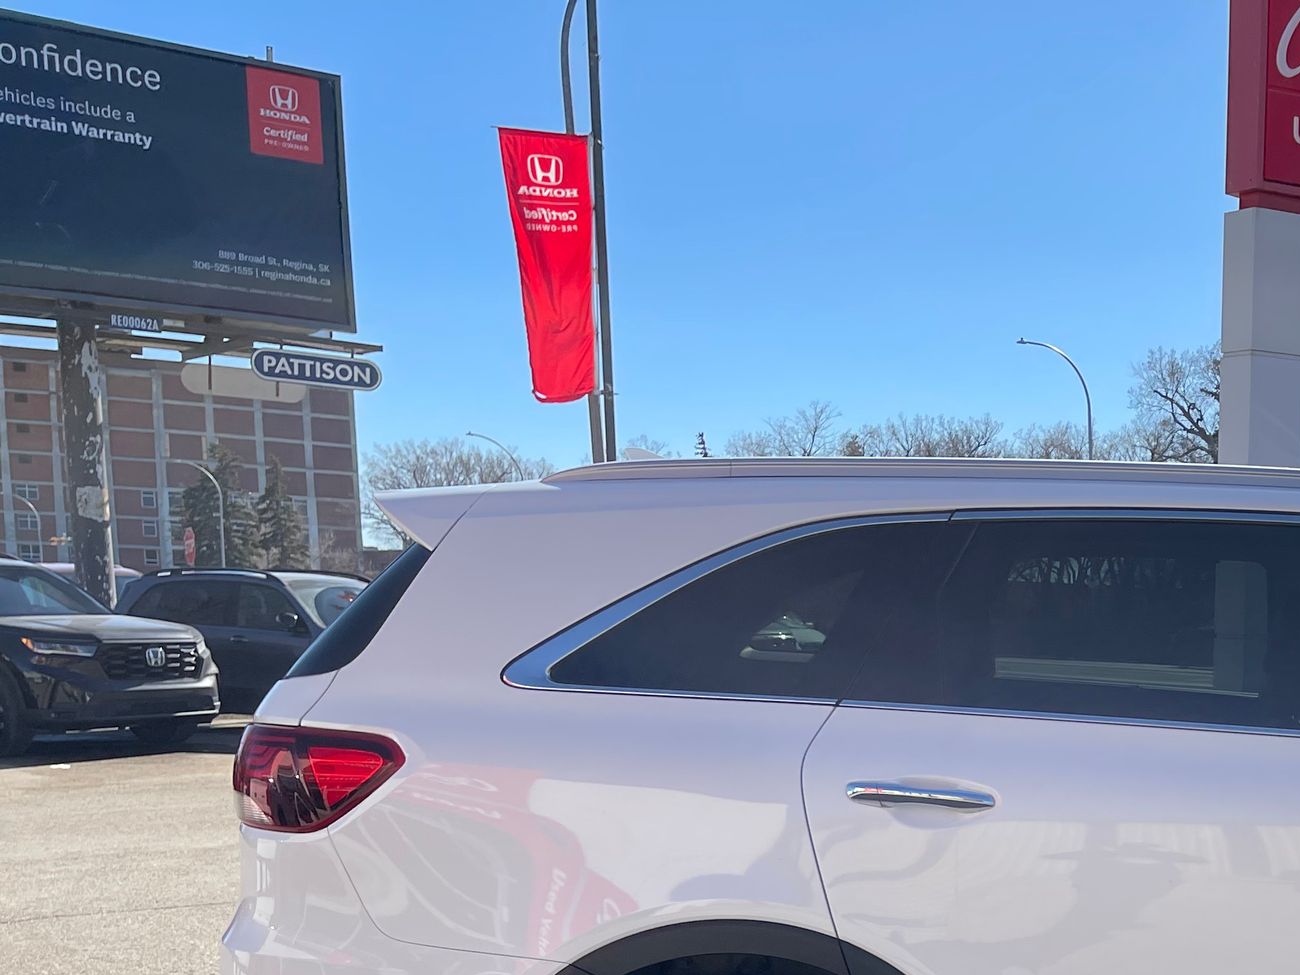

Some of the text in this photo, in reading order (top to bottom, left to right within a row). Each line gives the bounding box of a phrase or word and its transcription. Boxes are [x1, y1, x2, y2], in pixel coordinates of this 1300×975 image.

[0, 42, 161, 91] onfidence
[60, 97, 121, 120] include
[126, 111, 136, 123] a
[259, 108, 311, 124] HONDA
[71, 120, 153, 150] Warranty
[263, 126, 308, 142] Certified
[238, 251, 266, 265] Broad
[283, 258, 317, 272] Regina,
[318, 263, 331, 273] SK
[261, 269, 331, 286] reginahonda.ca
[110, 314, 160, 332] RE00062A
[262, 355, 371, 385] PATTISON
